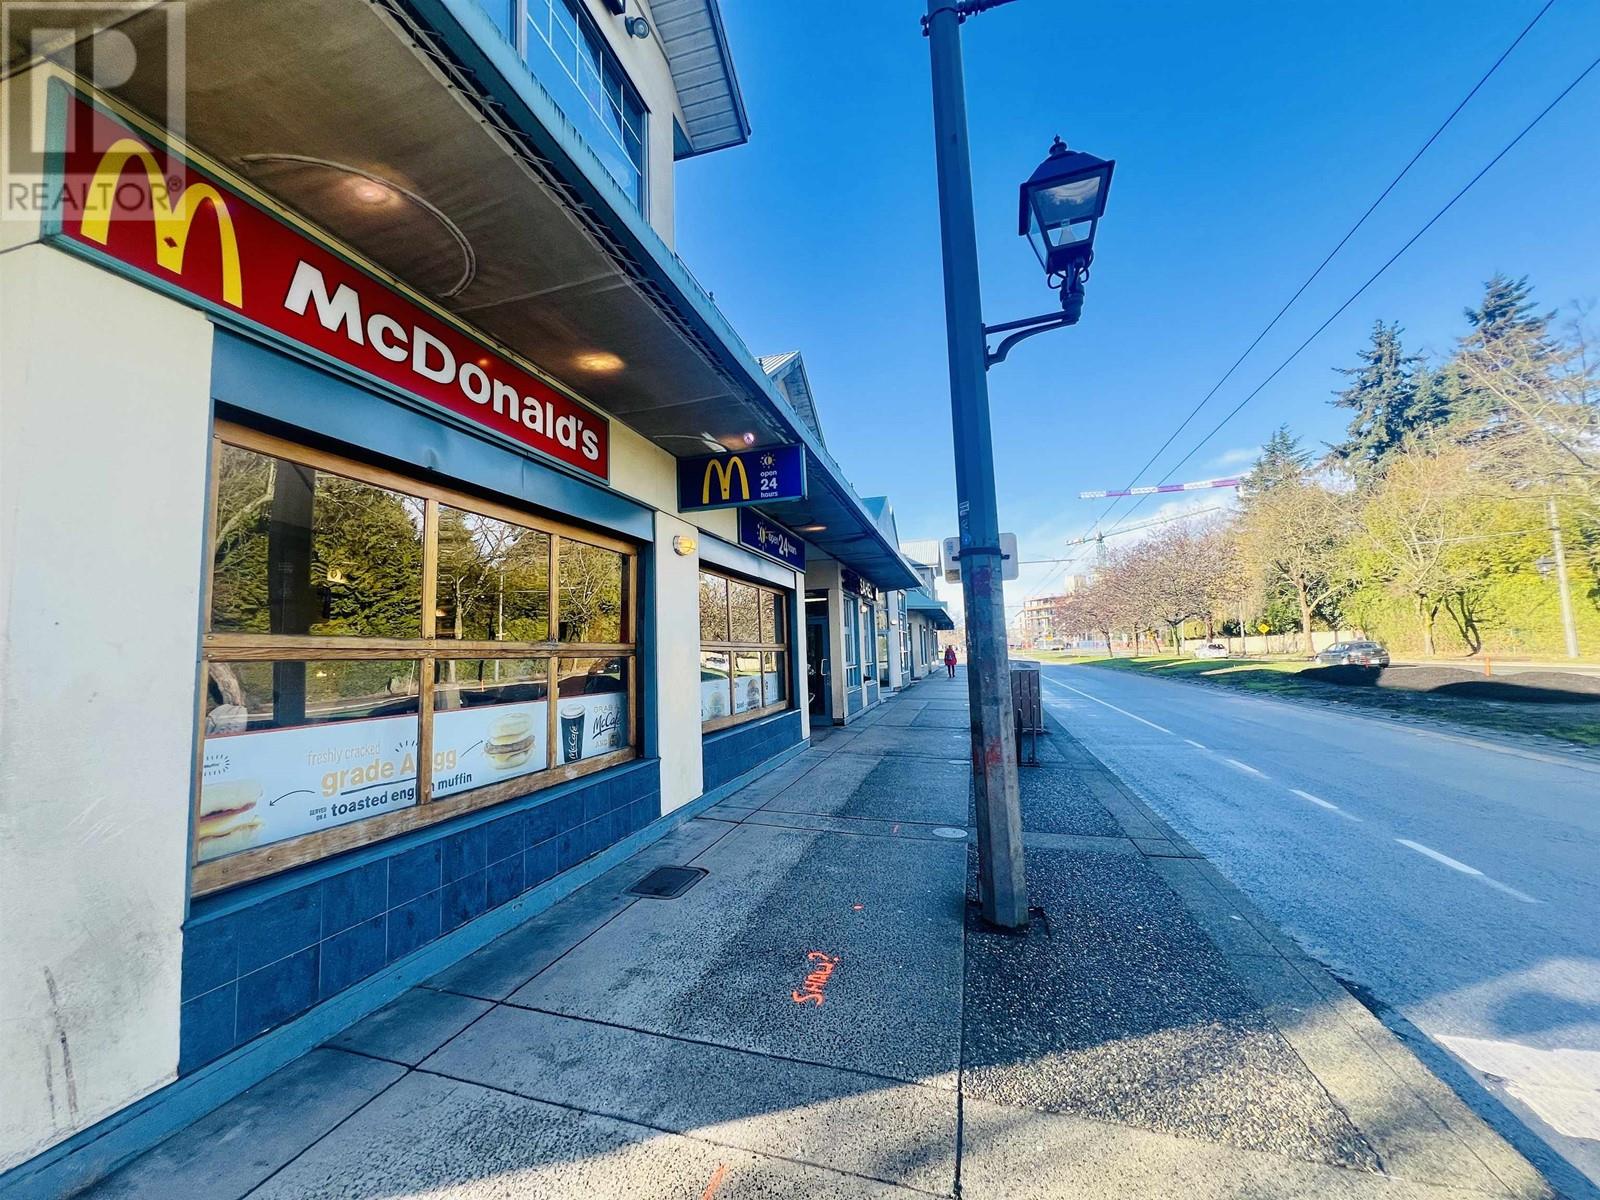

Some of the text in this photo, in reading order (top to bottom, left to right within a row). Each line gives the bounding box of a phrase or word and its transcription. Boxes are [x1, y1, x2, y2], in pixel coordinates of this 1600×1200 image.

[284, 260, 599, 461] McDonald's
[760, 469, 778, 478] open
[760, 477, 778, 491] 24
[760, 490, 778, 498] hours
[779, 534, 789, 558] 24
[308, 743, 381, 766] freshly cracked
[321, 749, 457, 798] grade A gg
[331, 791, 389, 817] toasted
[438, 772, 473, 791] muffin
